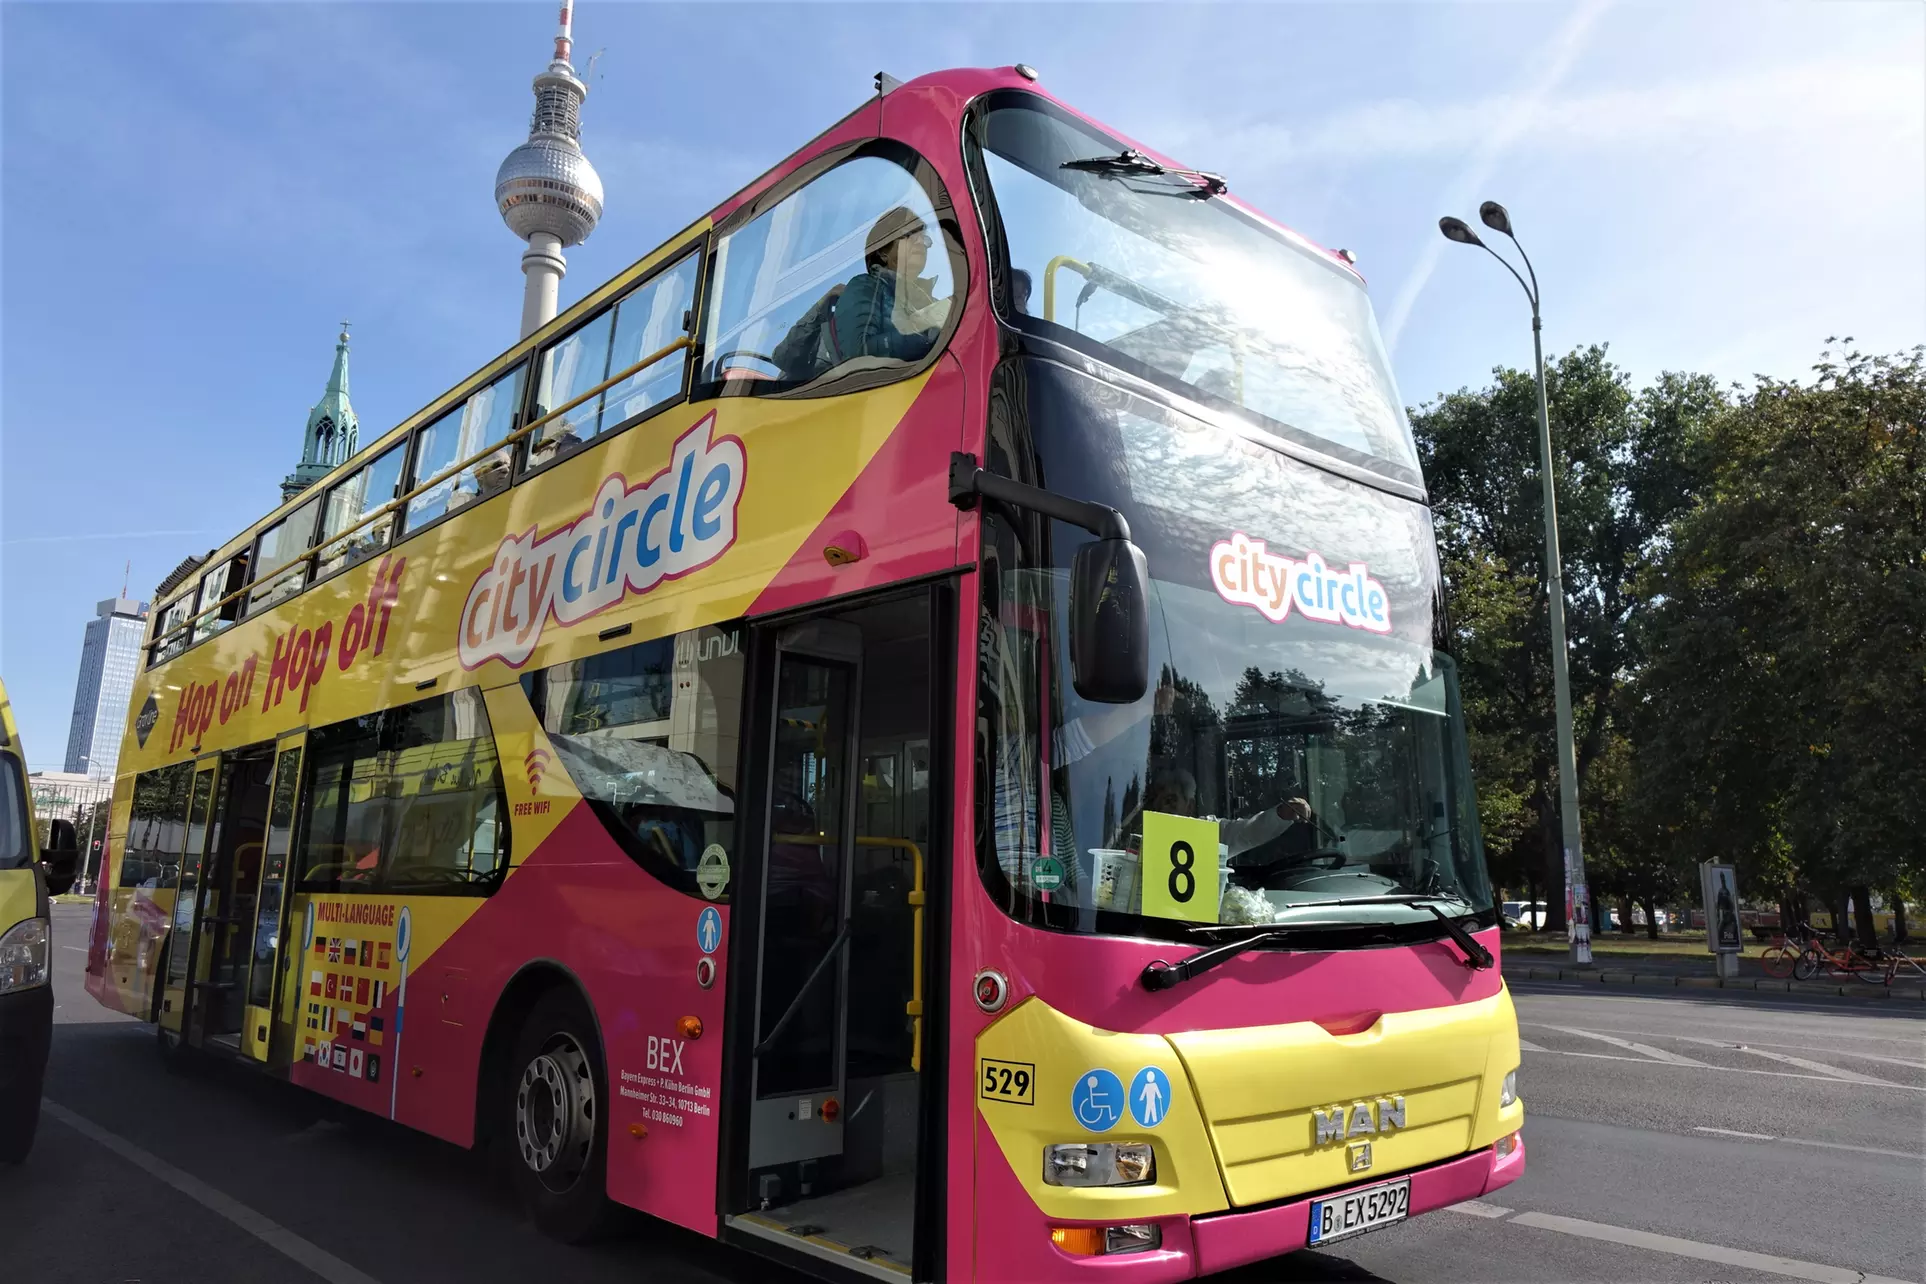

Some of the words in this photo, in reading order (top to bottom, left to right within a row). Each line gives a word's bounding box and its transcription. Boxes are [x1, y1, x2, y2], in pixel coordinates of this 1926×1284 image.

[169, 680, 219, 755] Hop
[219, 651, 259, 726] on
[261, 620, 333, 714] Hop
[338, 553, 407, 671] off
[514, 802, 532, 816] FREE
[1042, 859, 1053, 874] 4
[1168, 840, 1196, 903] 8
[647, 1036, 684, 1075] BEX
[621, 1070, 637, 1082] Bayern
[638, 1073, 656, 1086] Express
[678, 1081, 694, 1095] Berlin
[694, 1085, 710, 1098] GmbH
[984, 1066, 1030, 1097] 529
[620, 1085, 650, 1102] Mannheimer
[650, 1092, 658, 1104] Str.
[678, 1100, 693, 1112] 10713
[694, 1102, 710, 1116] Berlin
[642, 1107, 651, 1119] Tel.
[651, 1109, 662, 1122] 030
[662, 1112, 684, 1127] 860960
[1313, 1094, 1406, 1145] MAN
[1322, 1205, 1333, 1235] B
